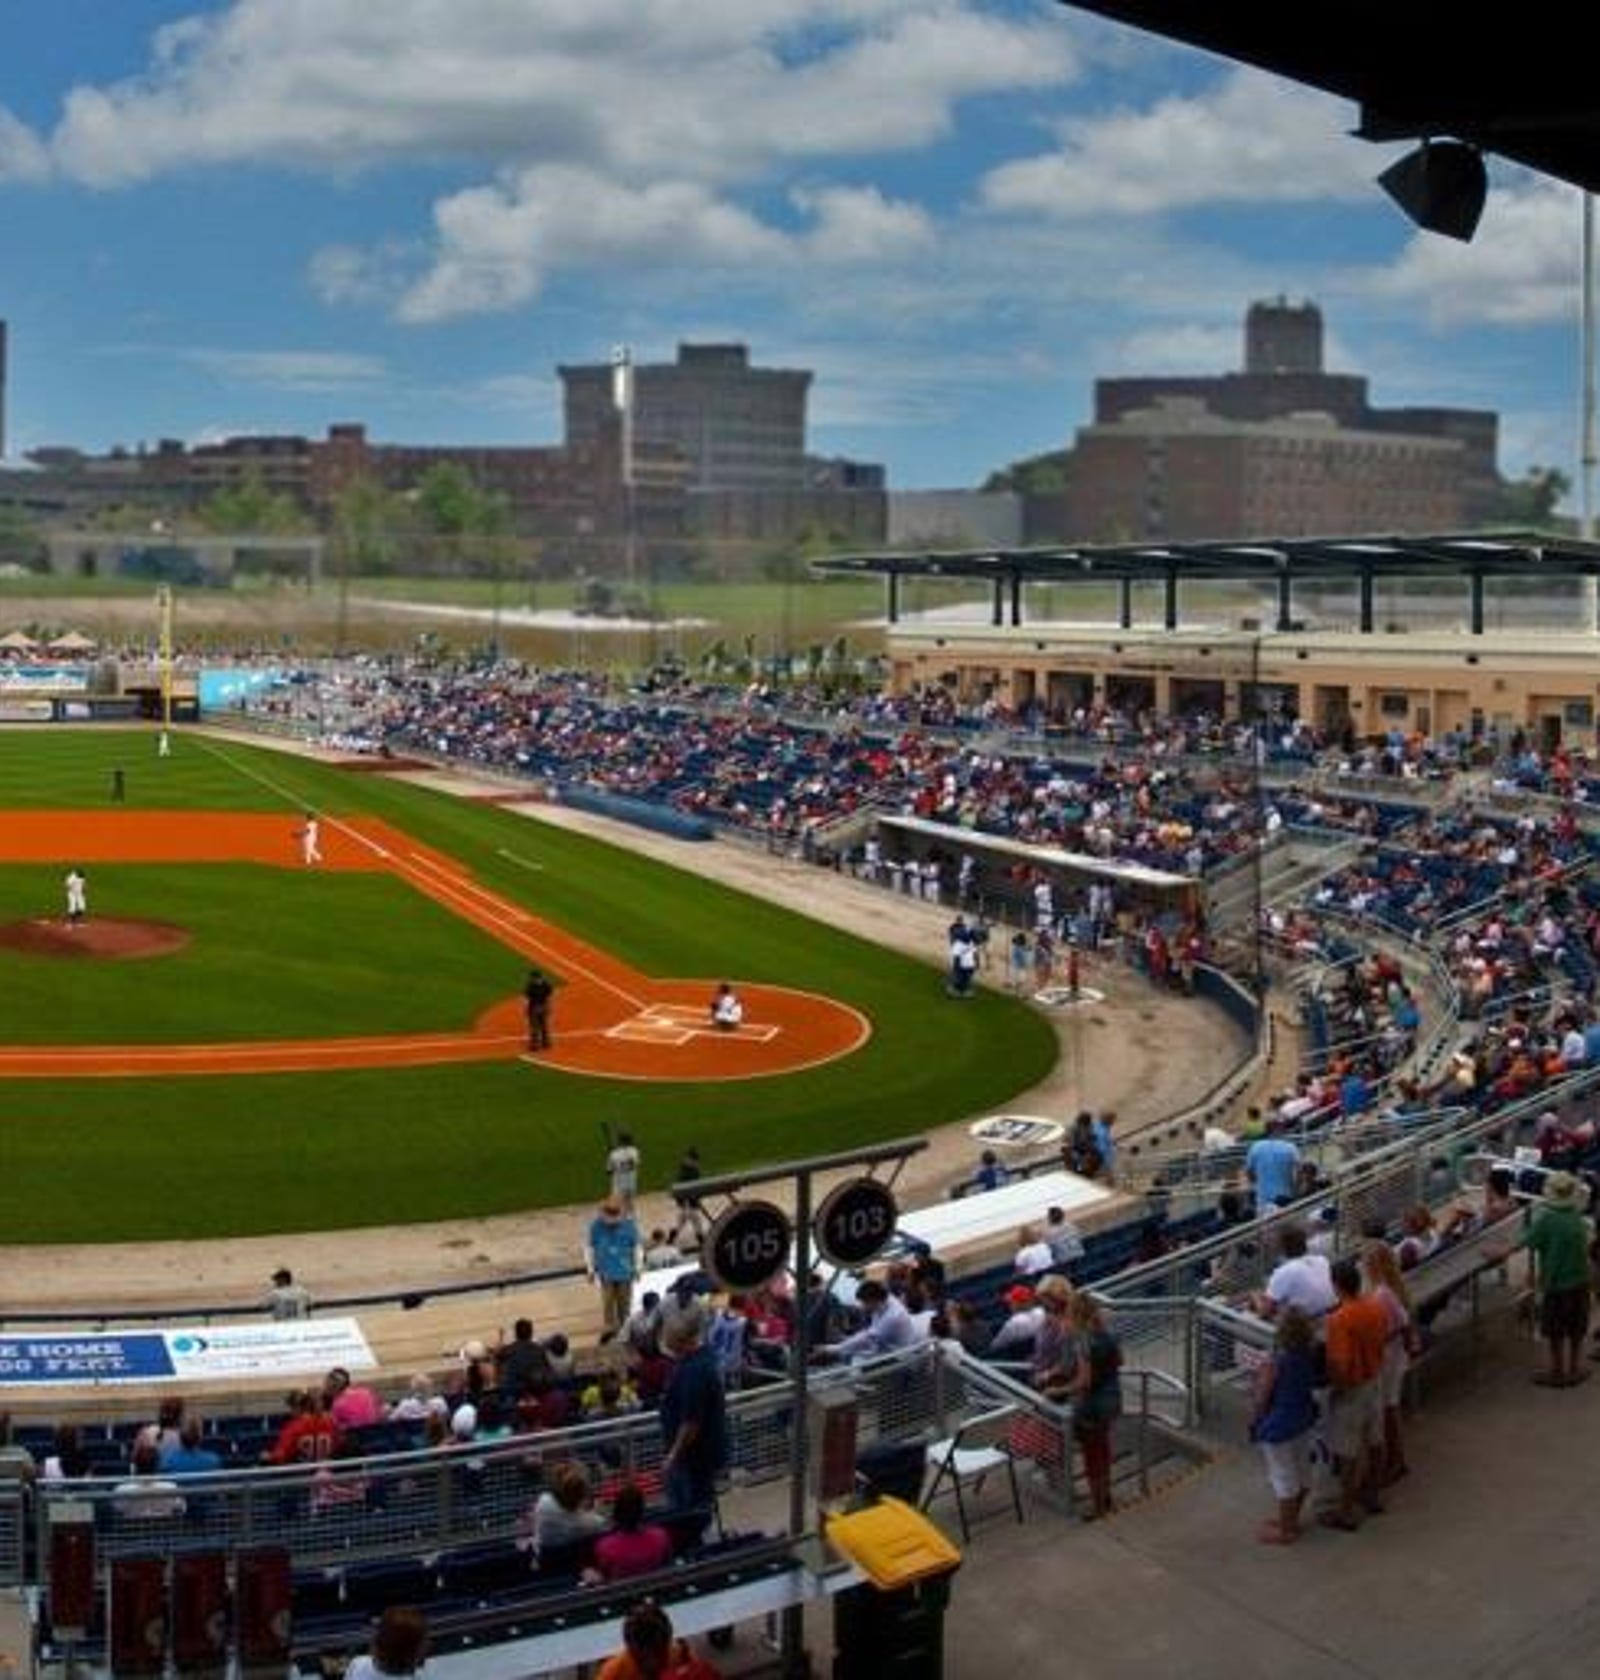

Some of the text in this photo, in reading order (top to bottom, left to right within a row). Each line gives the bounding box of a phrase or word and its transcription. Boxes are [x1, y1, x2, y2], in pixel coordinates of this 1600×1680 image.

[835, 1206, 886, 1242] 103
[724, 1228, 780, 1268] 105
[27, 1341, 125, 1358] HOME
